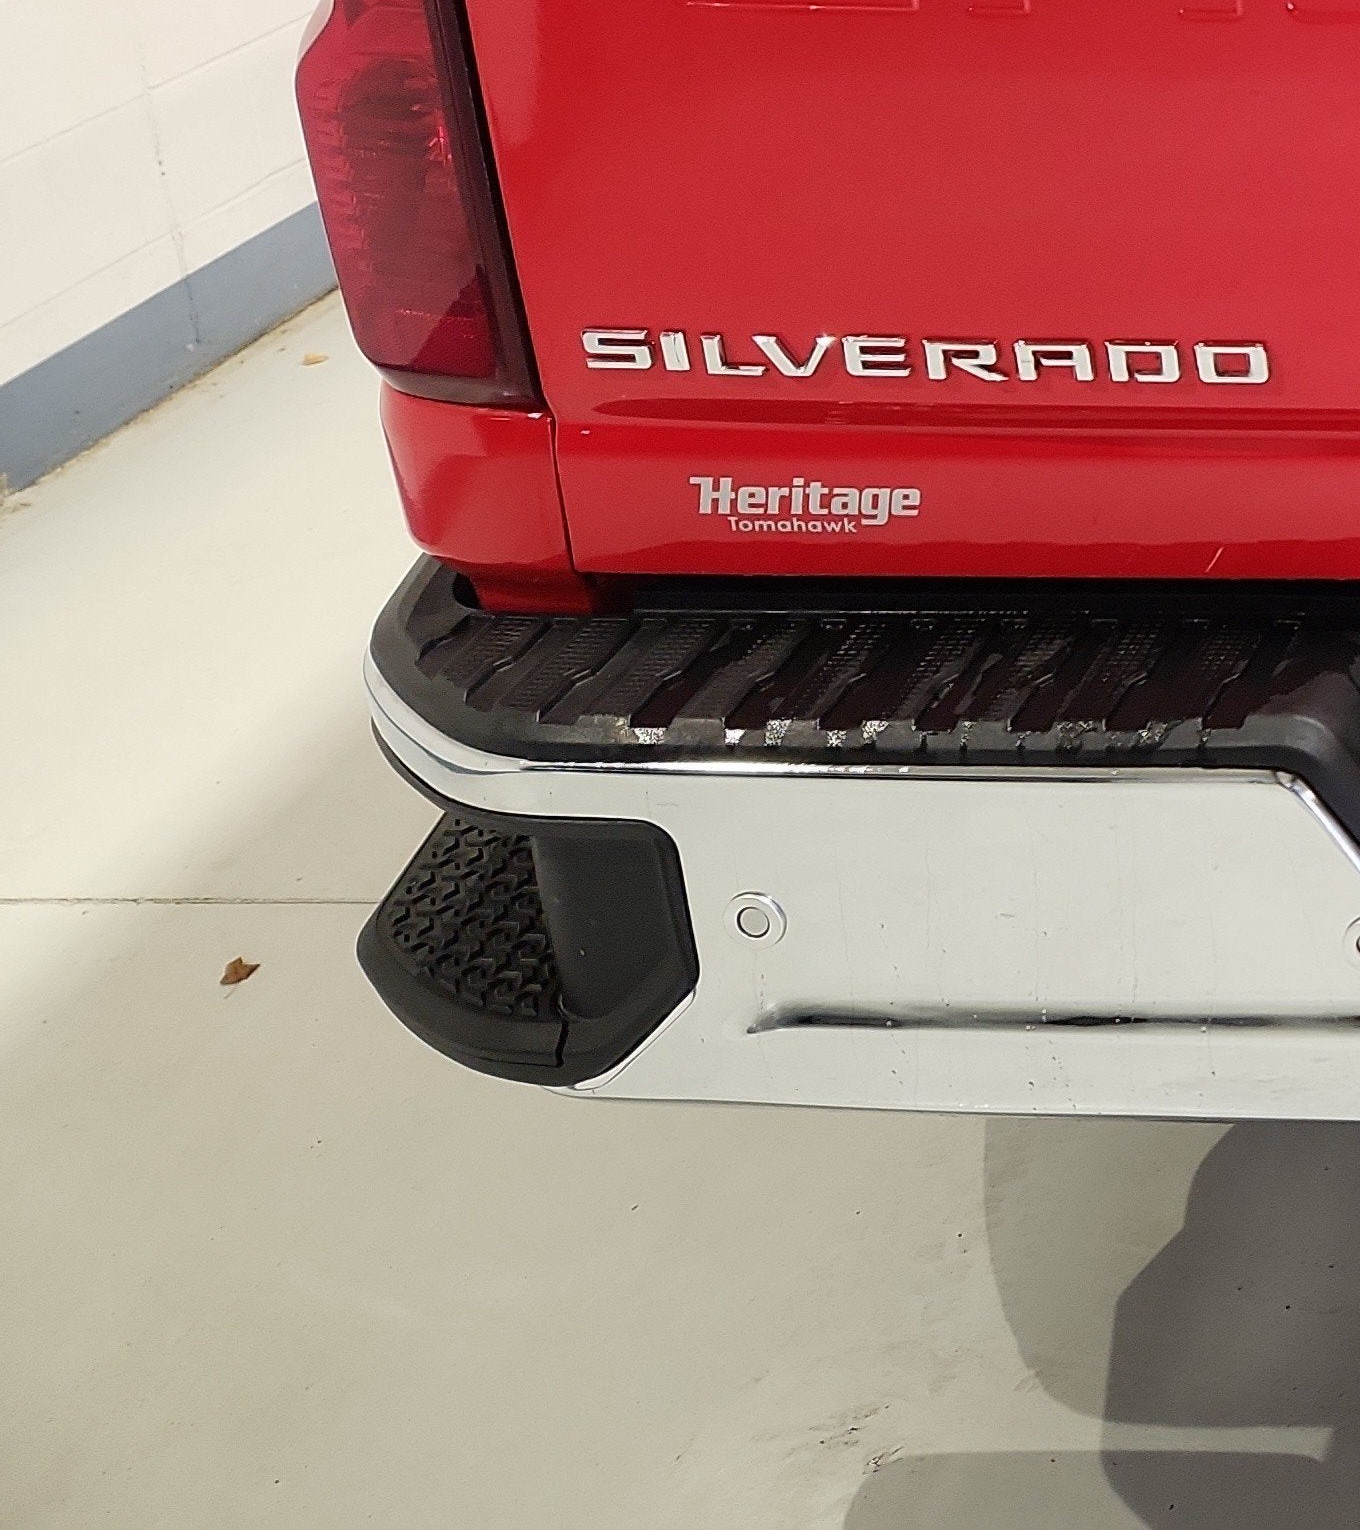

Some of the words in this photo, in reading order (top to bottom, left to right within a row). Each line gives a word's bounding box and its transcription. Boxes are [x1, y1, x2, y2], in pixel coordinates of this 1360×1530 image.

[581, 327, 1270, 384] SILVERADO
[689, 476, 921, 526] Heritage
[726, 517, 857, 534] Tomahawk
